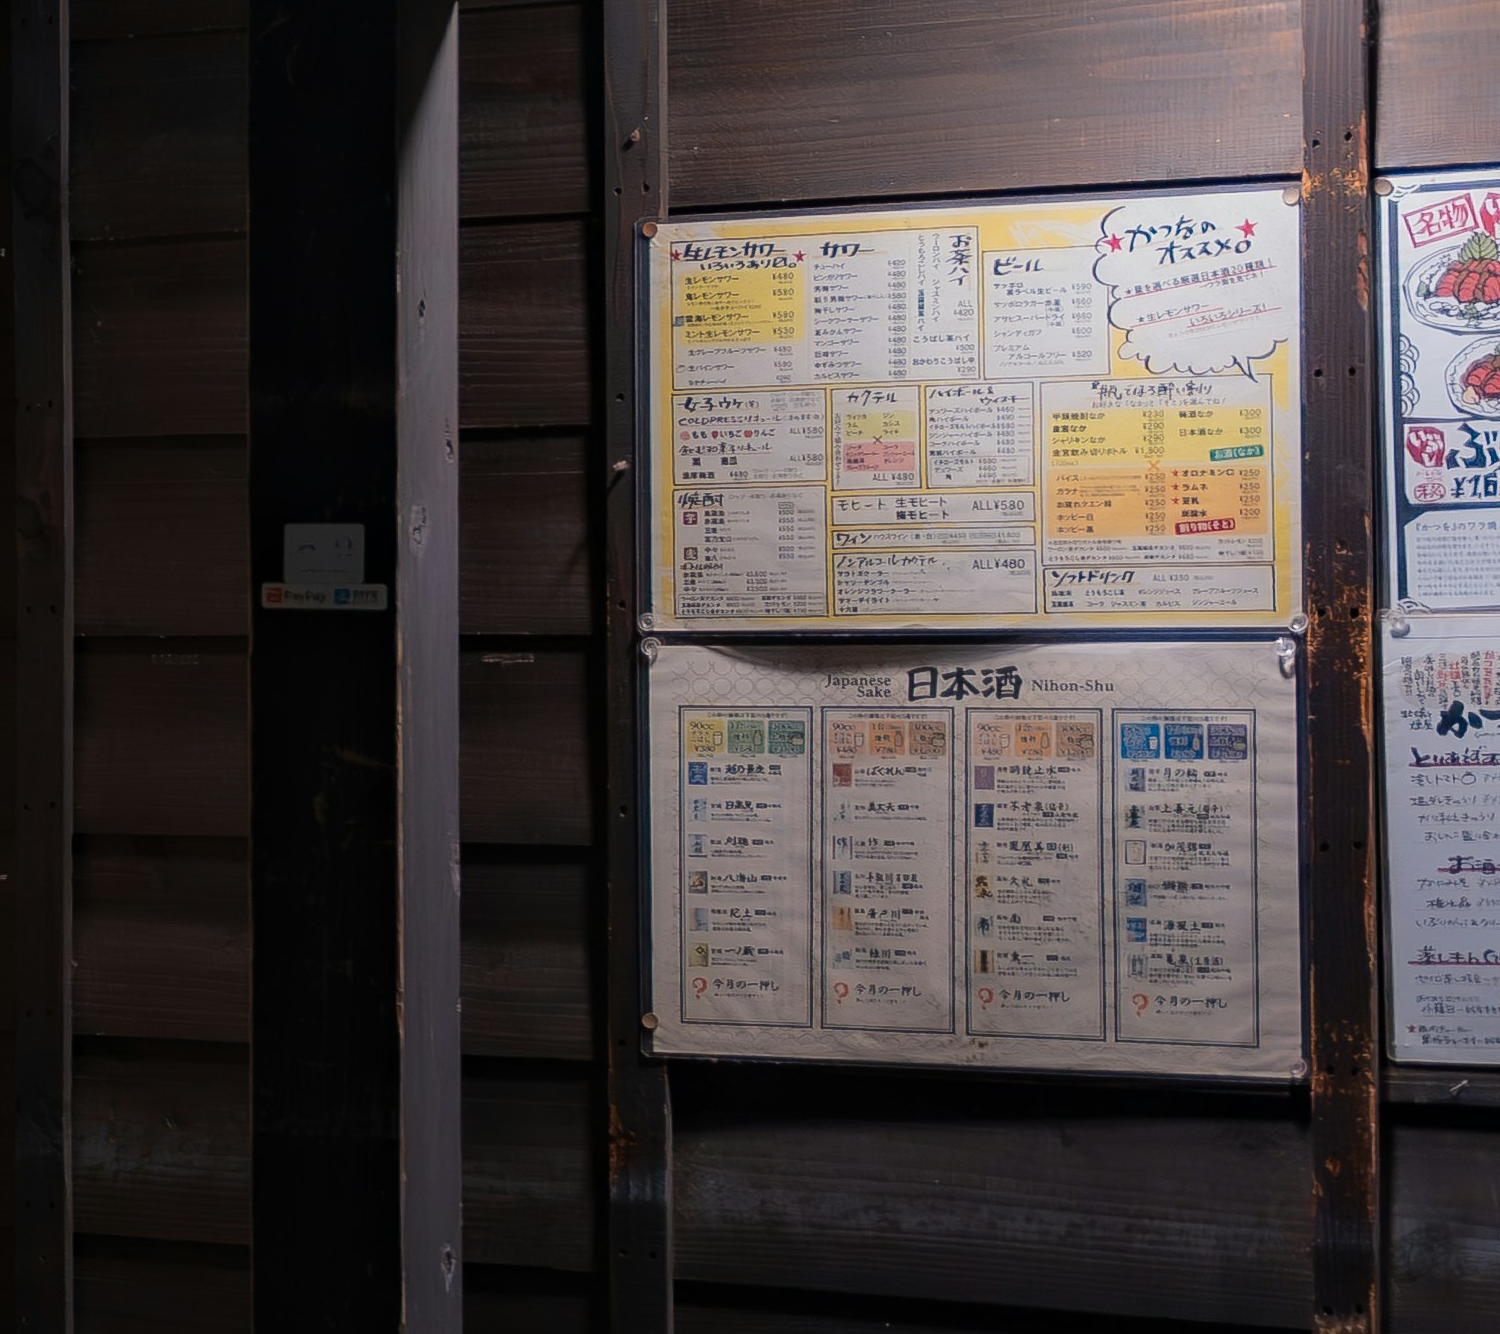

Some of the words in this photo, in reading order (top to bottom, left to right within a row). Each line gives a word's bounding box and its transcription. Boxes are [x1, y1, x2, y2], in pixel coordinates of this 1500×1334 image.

[1413, 202, 1469, 237] 名物
[683, 241, 786, 261] 生レモンサワー
[820, 242, 875, 258] サワー
[945, 233, 973, 286] お茶ハイ
[994, 257, 1044, 275] ビール
[685, 276, 739, 285] 生レモンサワー
[1147, 304, 1209, 319] 生レモンサワー
[846, 390, 898, 406] カクテル
[678, 491, 724, 509] 焼酎
[837, 499, 886, 511] モヒート
[895, 497, 947, 508] 生モヒート
[836, 532, 872, 546] ワイン
[1051, 570, 1135, 587] ソフトドリンク
[825, 674, 891, 688] Japanese
[907, 667, 1023, 701] 日本酒
[1032, 679, 1114, 693] Nihon-Shu
[856, 686, 891, 698] Sake
[713, 978, 779, 991] 今月の一押し
[856, 983, 921, 997] 今月の一押し
[998, 989, 1070, 1002] 今月の一押し
[1155, 995, 1227, 1008] 今月の一押し
